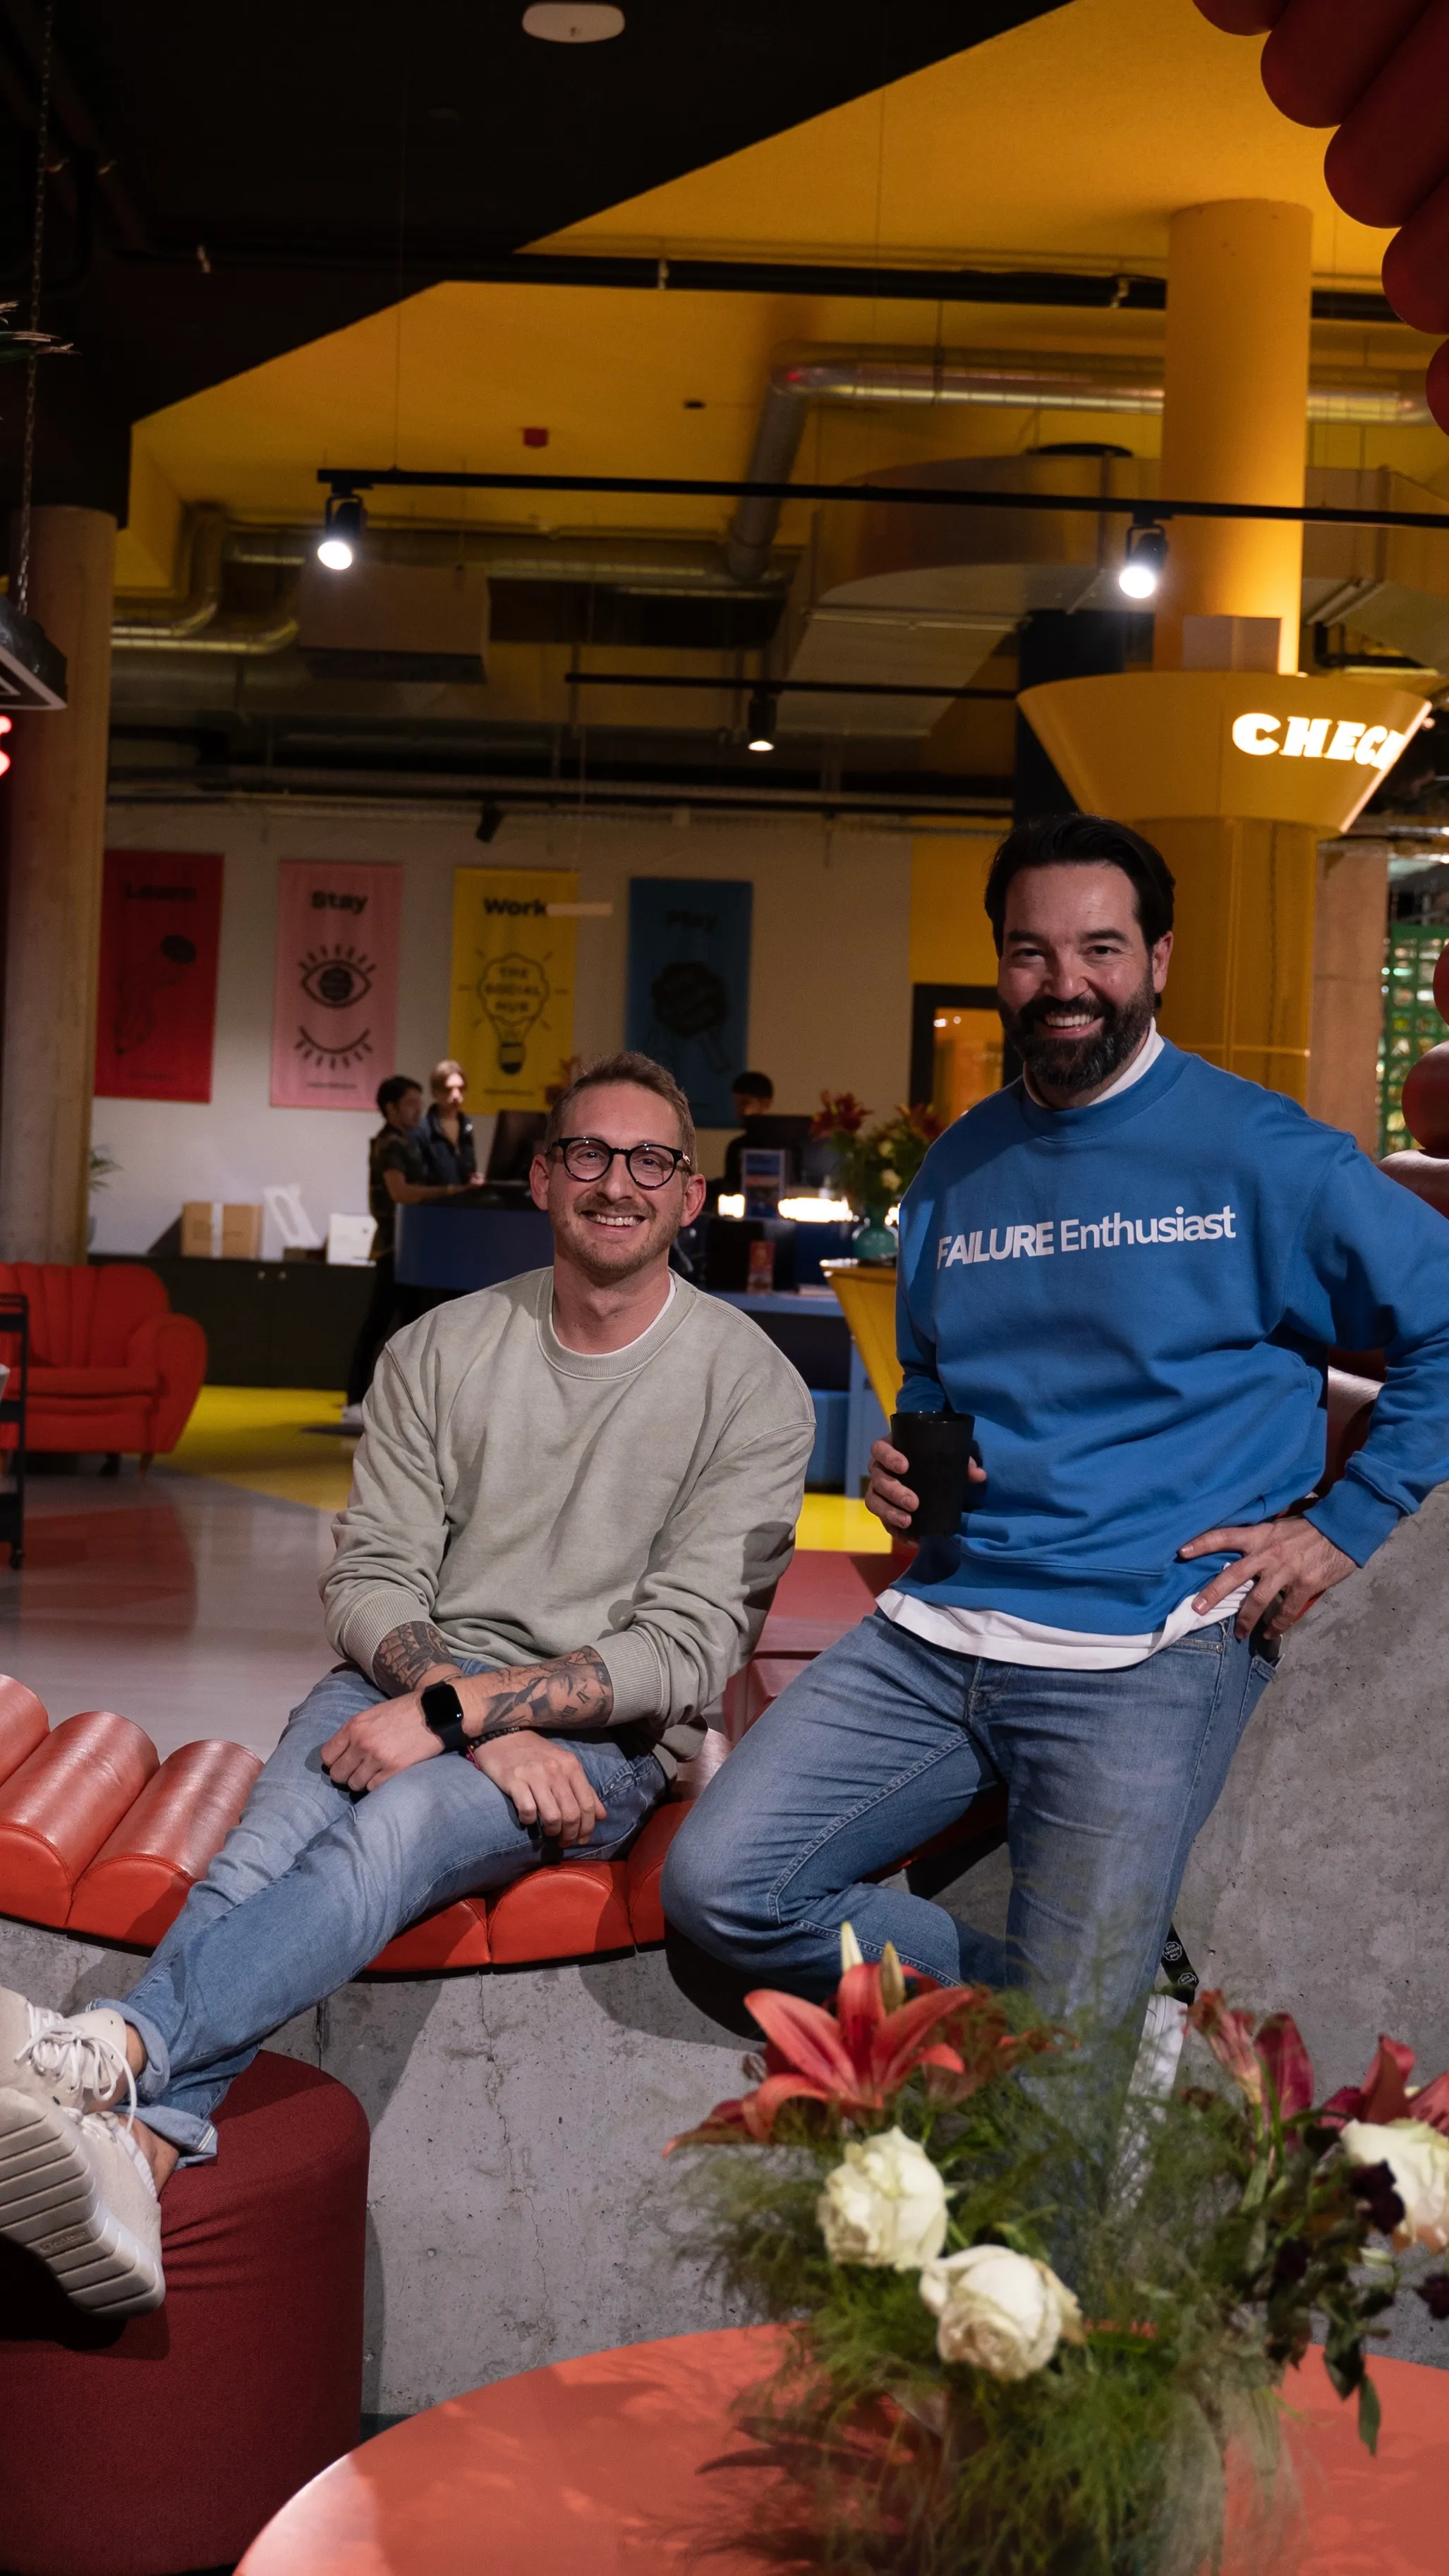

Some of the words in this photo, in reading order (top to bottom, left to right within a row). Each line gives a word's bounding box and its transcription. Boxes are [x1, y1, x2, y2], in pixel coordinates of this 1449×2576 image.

[311, 890, 368, 914] Stay
[484, 898, 547, 916] Work
[937, 1221, 1055, 1270] FAILURE
[1060, 1205, 1237, 1252] Enthusiast
